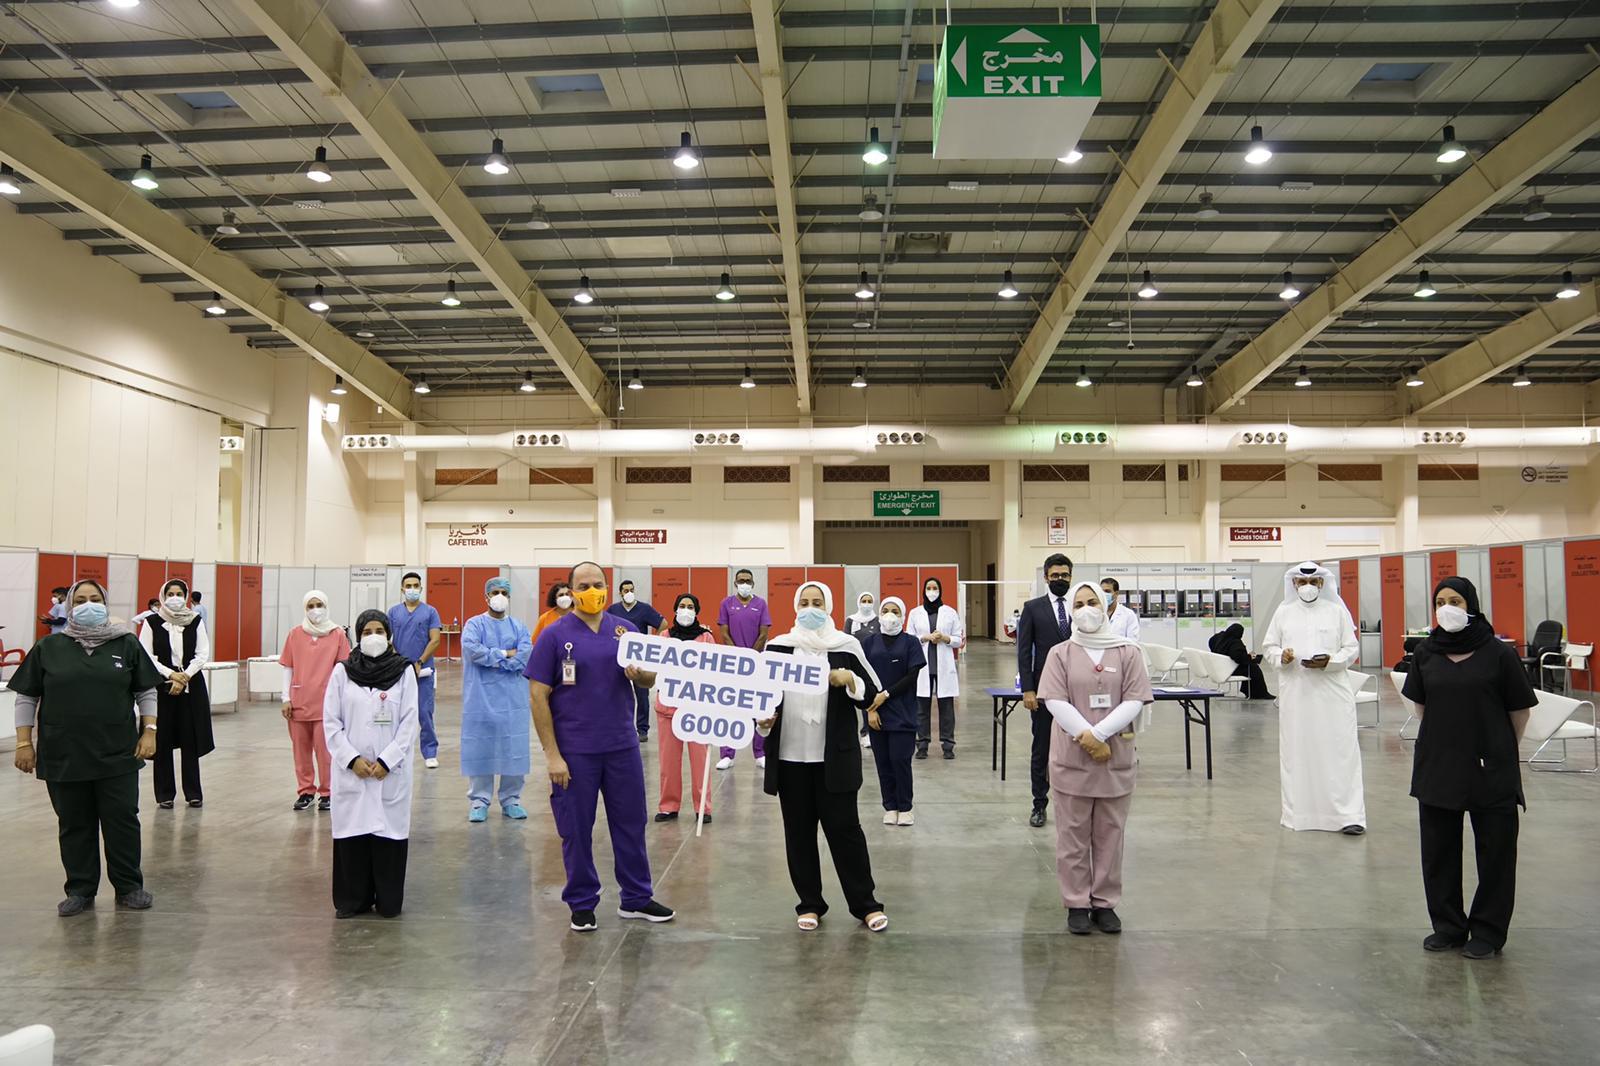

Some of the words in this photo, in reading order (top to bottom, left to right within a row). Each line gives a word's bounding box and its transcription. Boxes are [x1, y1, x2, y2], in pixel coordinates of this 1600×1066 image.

[983, 47, 1063, 72] مخرج
[984, 76, 1064, 94] EXIT
[448, 538, 488, 546] CAFETERIA
[626, 641, 756, 676] REACHED
[765, 660, 822, 686] THE
[664, 678, 774, 711] TARGET
[680, 713, 746, 740] 6000
